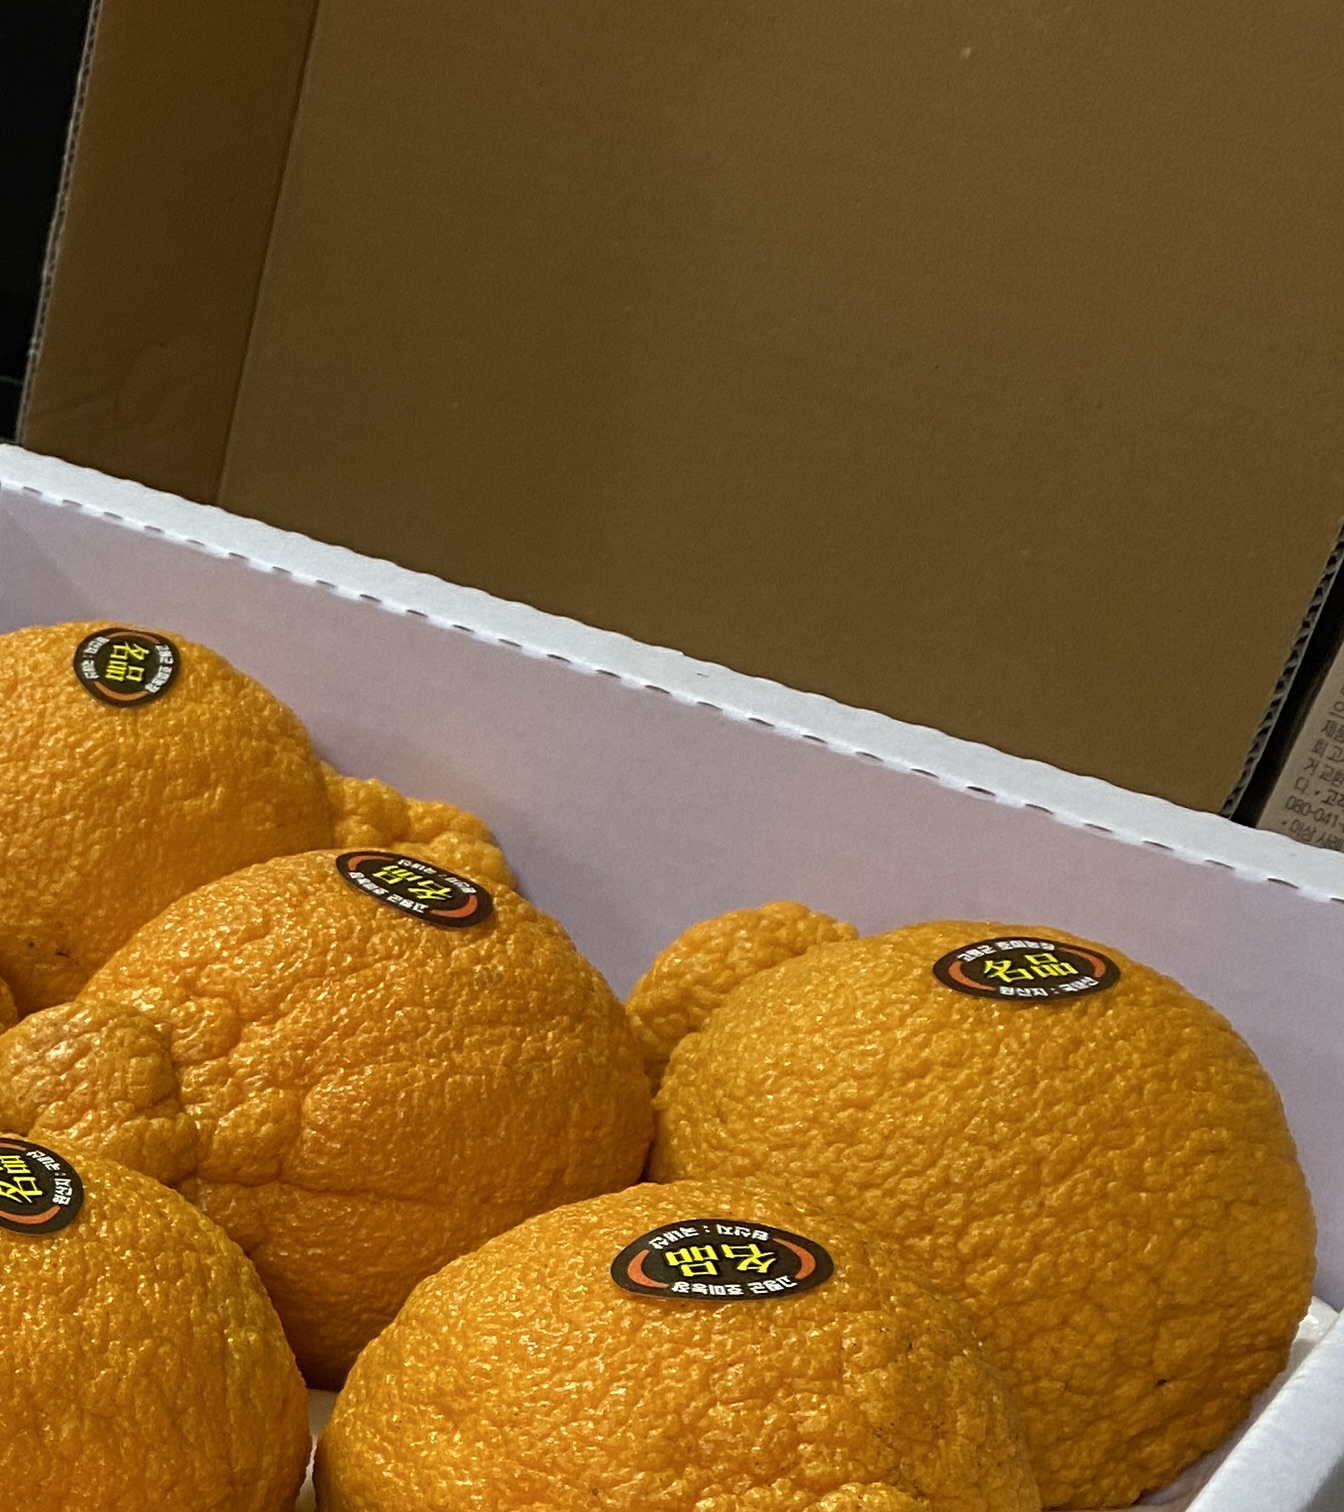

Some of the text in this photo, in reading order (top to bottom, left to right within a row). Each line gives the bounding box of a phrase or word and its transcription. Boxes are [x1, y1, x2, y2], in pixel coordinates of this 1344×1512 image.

[105, 641, 149, 682] 名品
[372, 864, 453, 900] 名品
[984, 953, 1078, 983] 名品
[649, 1227, 700, 1249] 국내산
[717, 1225, 770, 1241] 원산지
[665, 1244, 774, 1277] 名品
[749, 1276, 798, 1294] 고령군
